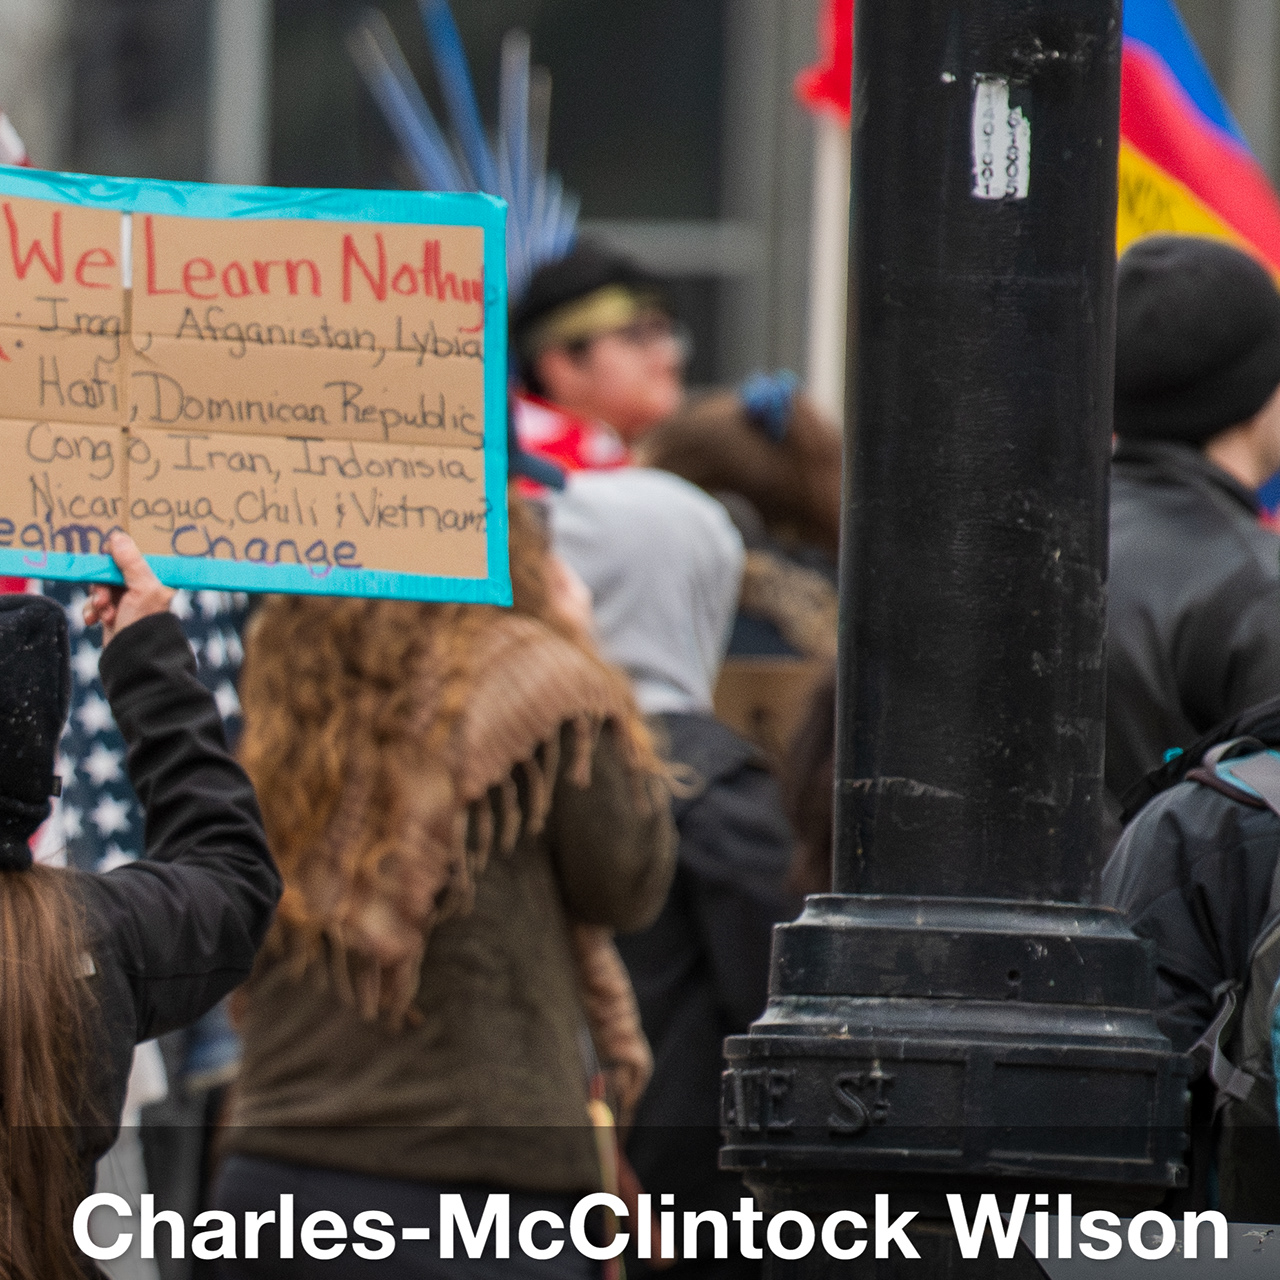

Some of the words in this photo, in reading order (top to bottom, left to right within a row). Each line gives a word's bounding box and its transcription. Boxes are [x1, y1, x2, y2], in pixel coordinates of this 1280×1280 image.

[3, 203, 116, 289] We
[143, 215, 322, 301] Learn
[131, 369, 328, 426] Dominican
[167, 434, 280, 484] Iran,
[171, 525, 363, 578] Change
